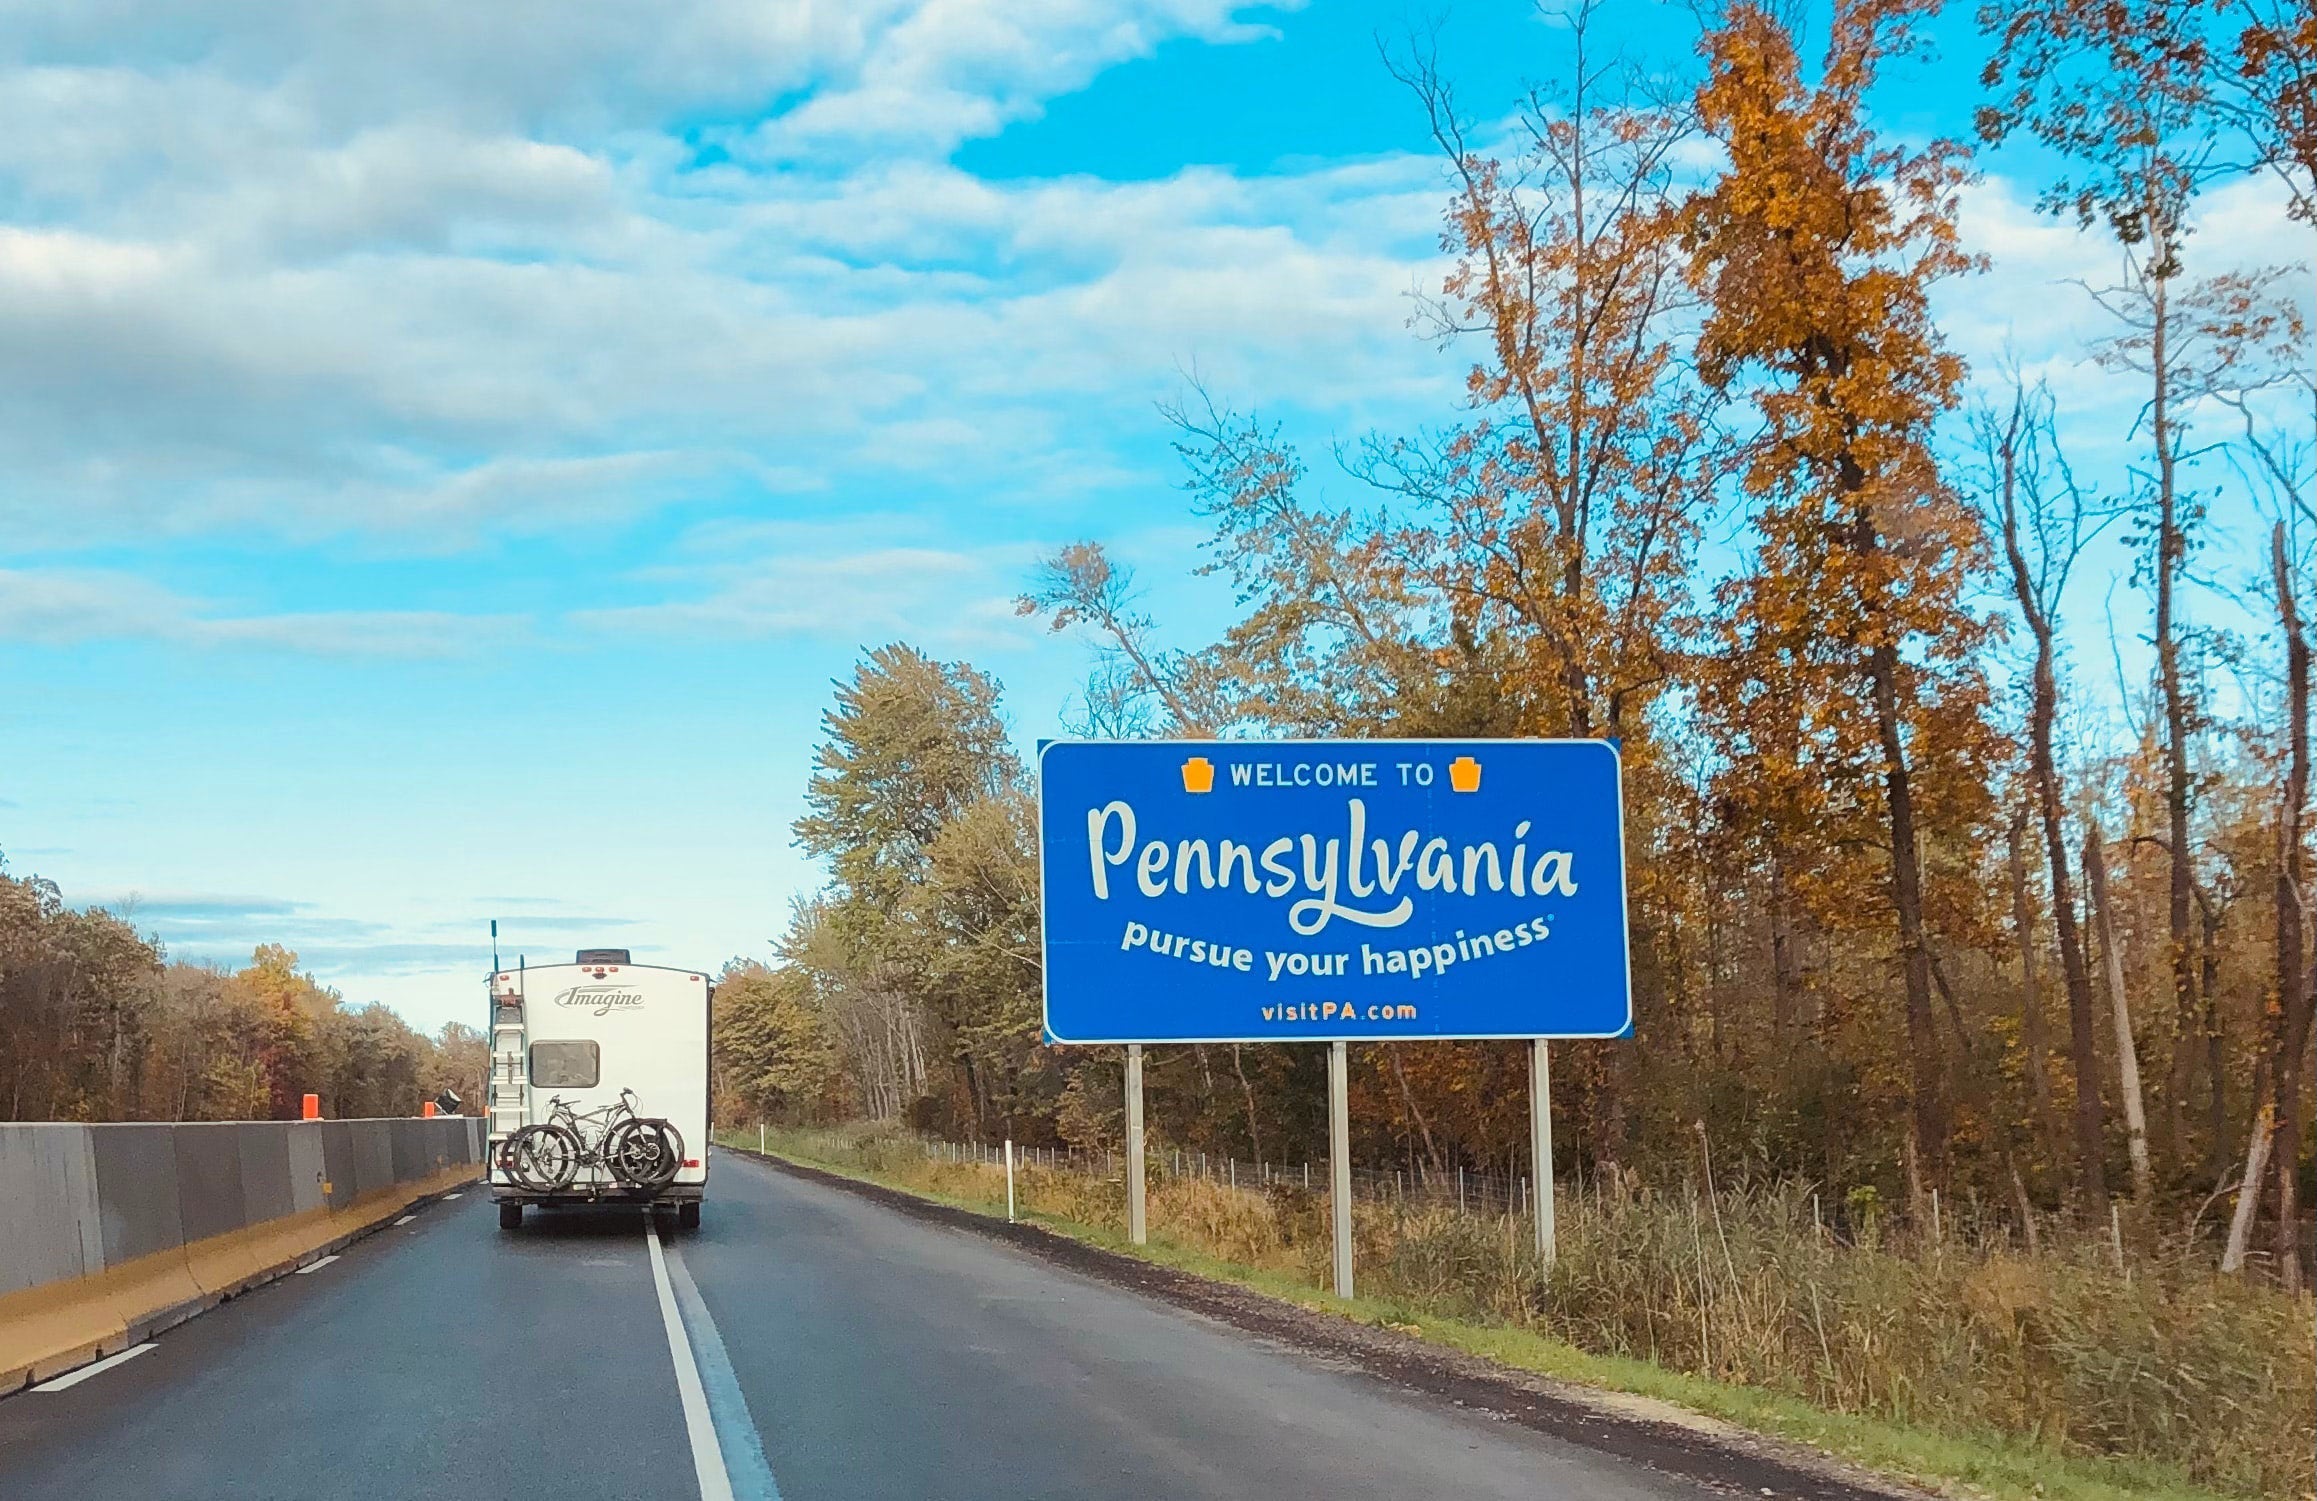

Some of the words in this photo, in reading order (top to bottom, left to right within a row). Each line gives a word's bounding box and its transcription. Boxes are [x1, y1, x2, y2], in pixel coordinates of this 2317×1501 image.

[1231, 763, 1377, 786] WELCOME
[1397, 763, 1434, 786] TO
[1087, 798, 1578, 936] Pennsylvania
[1121, 921, 1253, 972] pursue
[1266, 950, 1349, 981] your
[1361, 916, 1550, 979] happiness
[564, 986, 644, 1016] Imagine
[1261, 1001, 1417, 1021] visitPA.com
